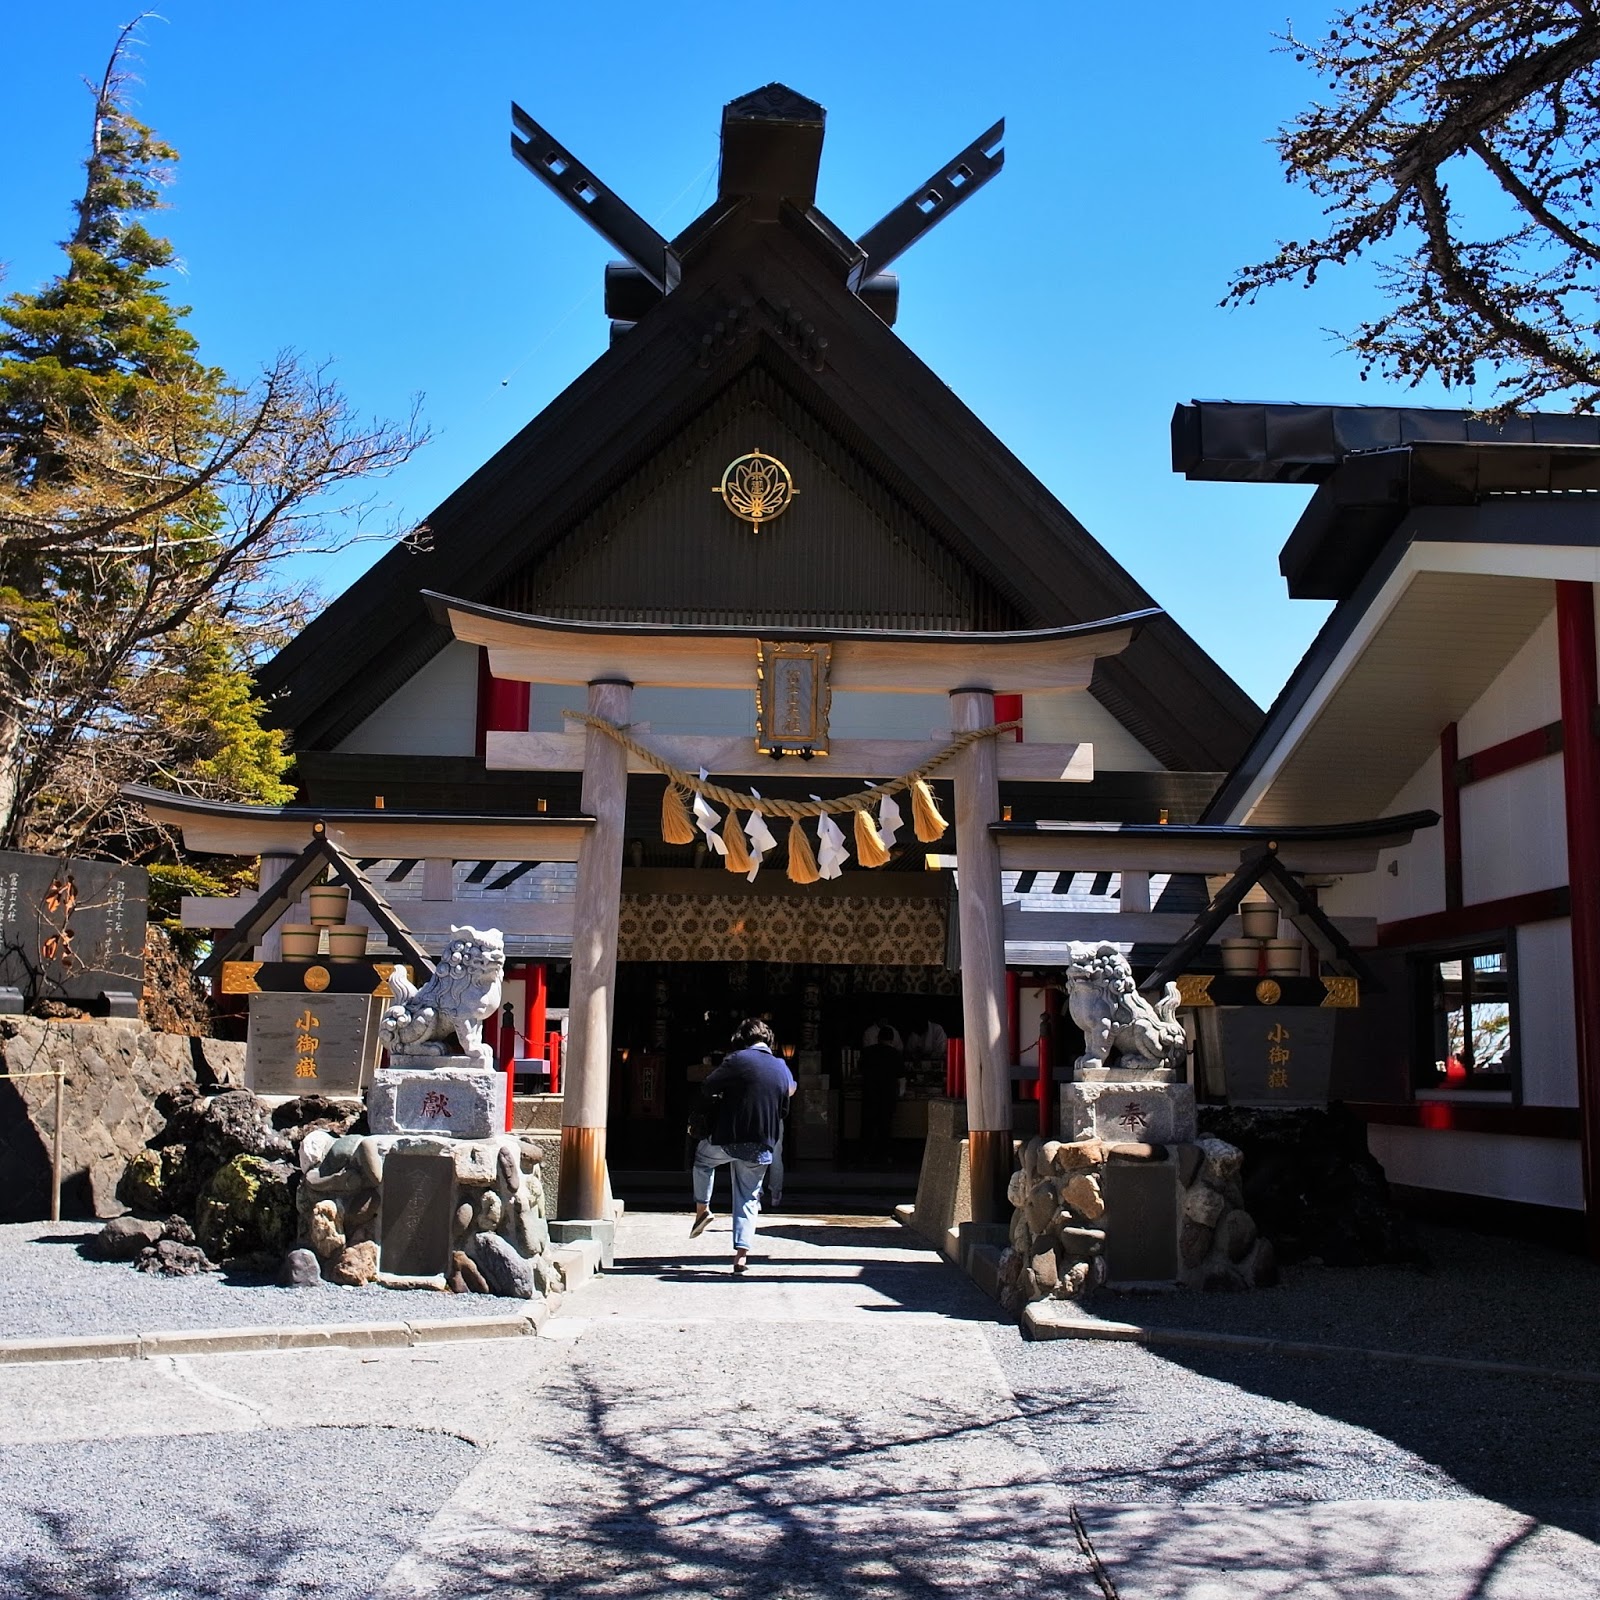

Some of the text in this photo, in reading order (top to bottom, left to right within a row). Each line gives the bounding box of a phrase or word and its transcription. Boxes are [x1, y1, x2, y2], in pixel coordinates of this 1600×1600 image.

[295, 1010, 320, 1078] 小御嶽
[1267, 1023, 1290, 1088] 小御嶽
[1119, 1102, 1151, 1132] 奉
